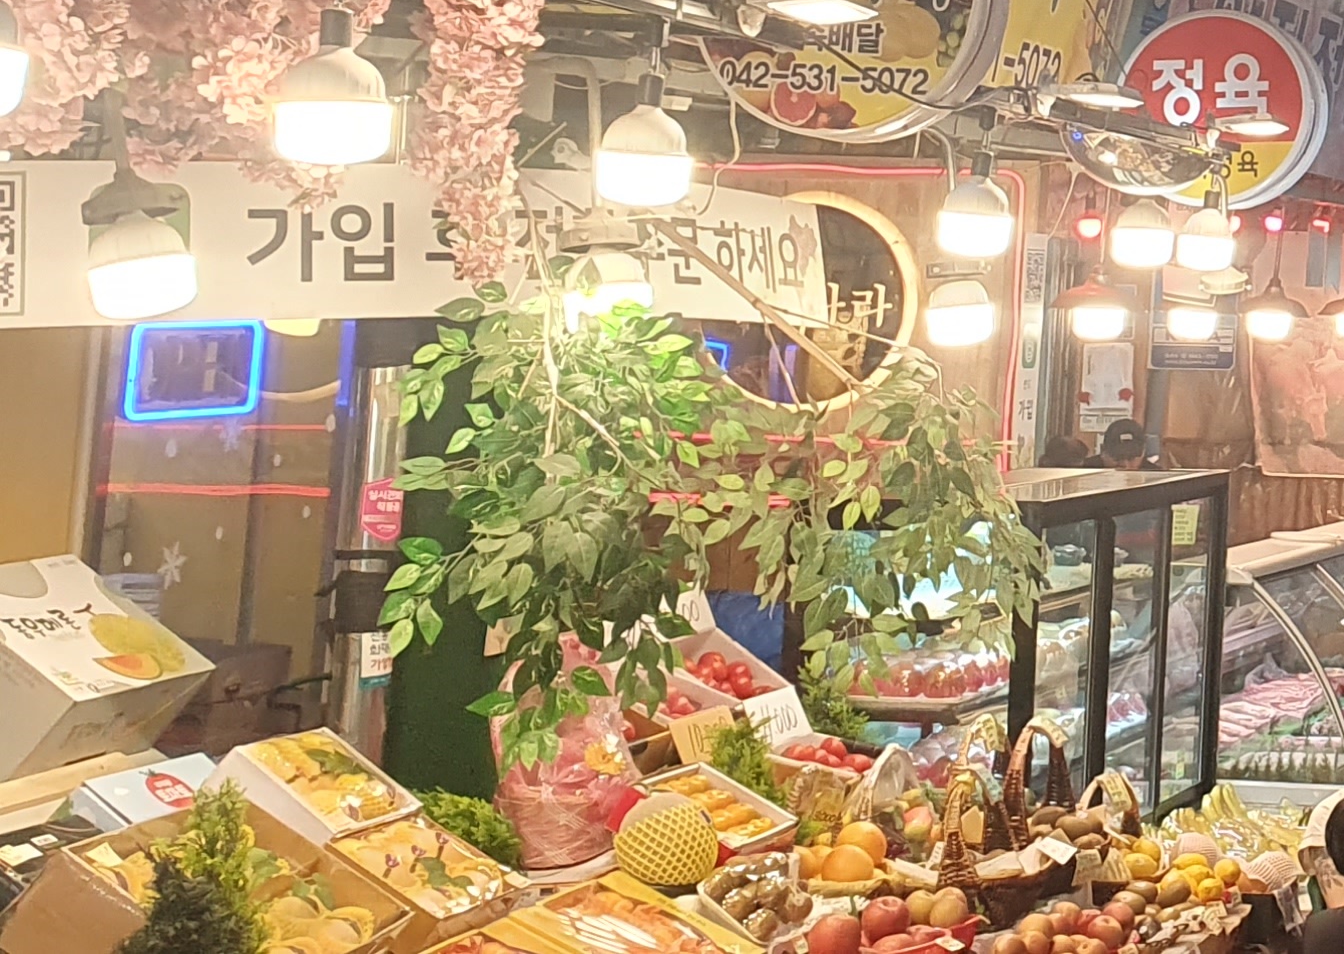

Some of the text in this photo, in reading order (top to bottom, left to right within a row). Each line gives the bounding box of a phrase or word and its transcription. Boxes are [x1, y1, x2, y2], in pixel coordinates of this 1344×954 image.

[719, 59, 930, 95] 042-531-5072
[1152, 53, 1270, 127] 정육
[246, 202, 395, 283] 가입
